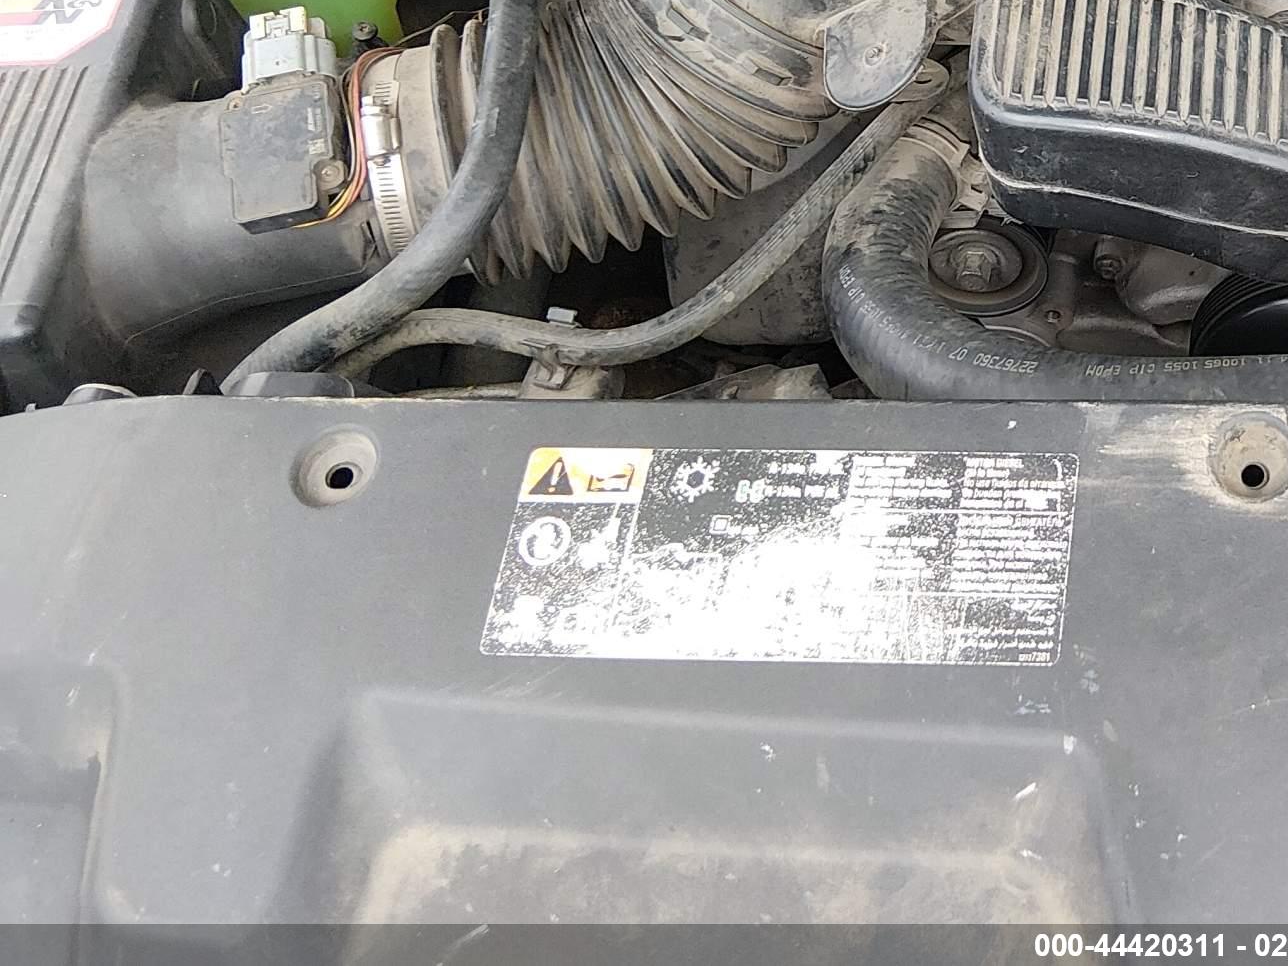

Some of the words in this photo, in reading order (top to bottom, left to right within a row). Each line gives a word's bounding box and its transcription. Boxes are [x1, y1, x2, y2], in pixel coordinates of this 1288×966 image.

[948, 346, 968, 361] 07
[973, 353, 1038, 373] 22767360
[1085, 363, 1122, 377] EPDM
[1129, 363, 1156, 375] CIP
